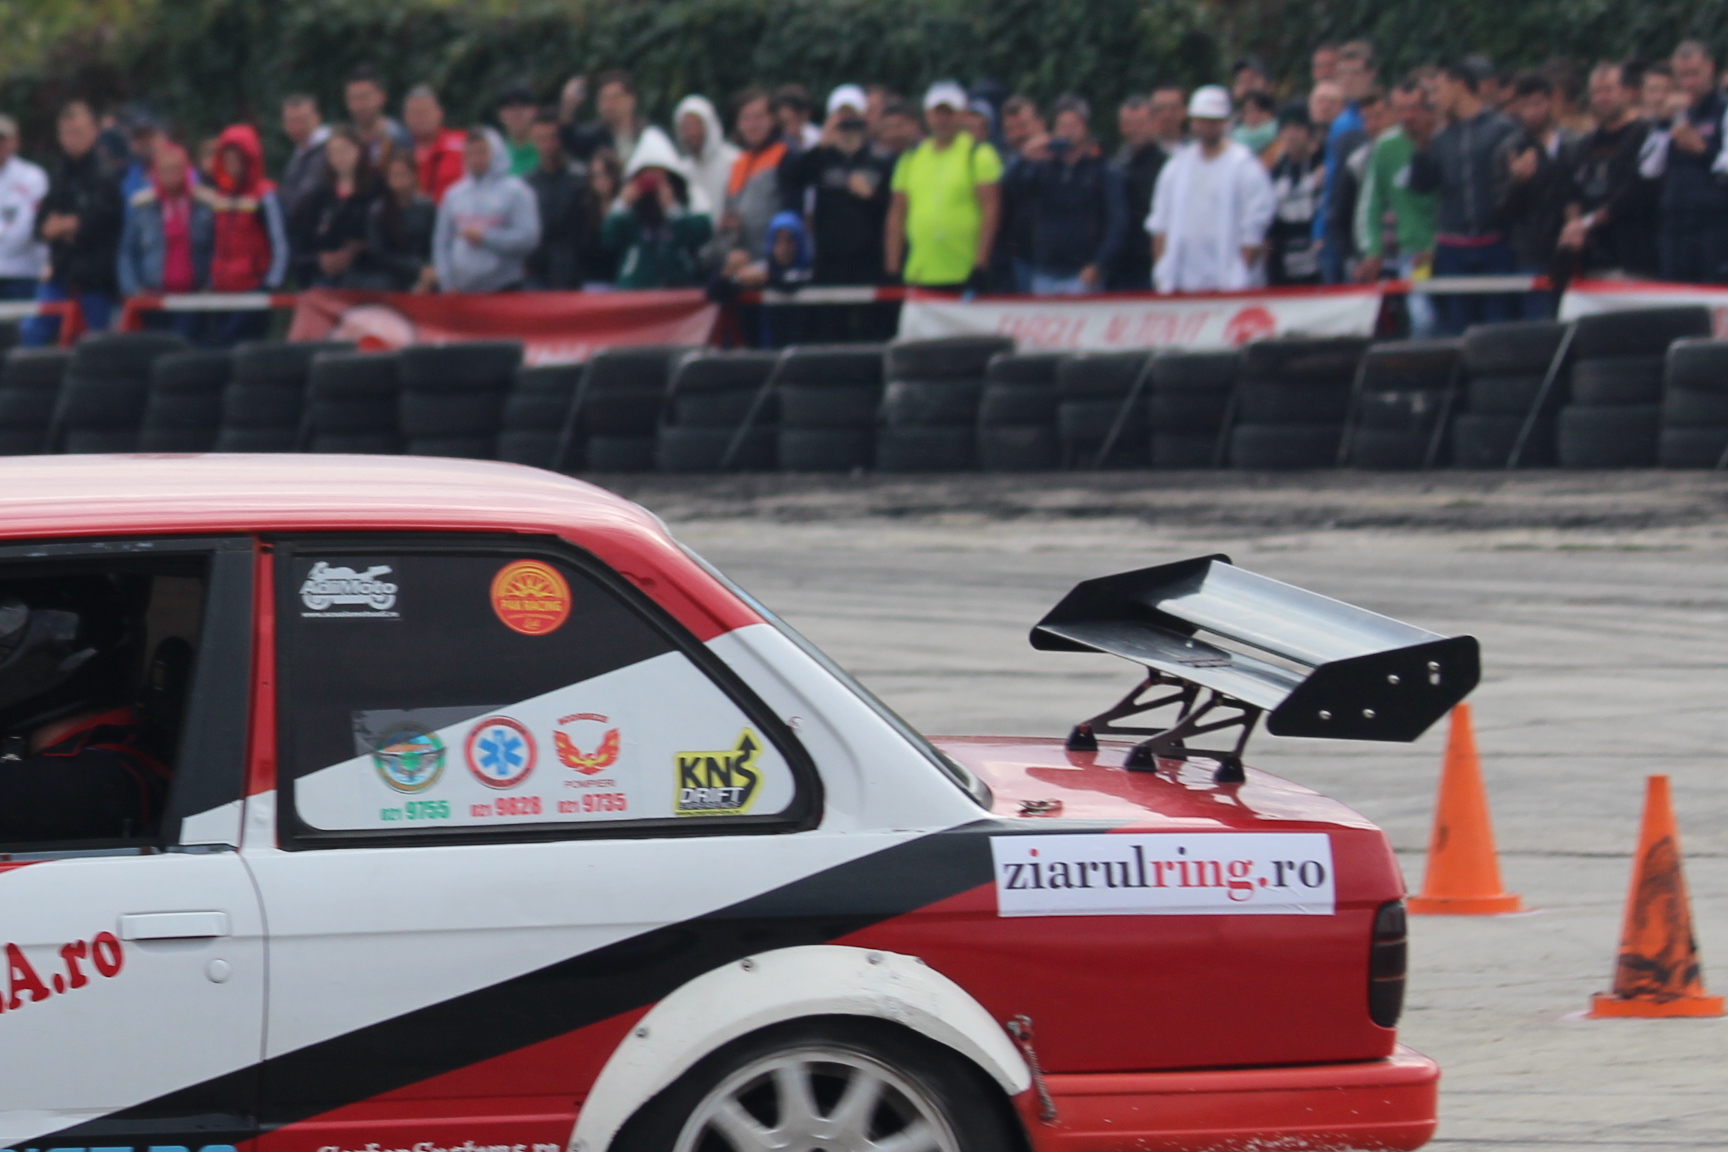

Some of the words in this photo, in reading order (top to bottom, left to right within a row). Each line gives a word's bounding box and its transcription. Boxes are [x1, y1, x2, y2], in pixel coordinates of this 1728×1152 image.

[679, 748, 757, 790] KNS
[582, 793, 627, 813] 9735
[679, 787, 745, 802] DRIFT
[405, 800, 450, 820] 9755
[1003, 845, 1326, 901] ziarulring.ro
